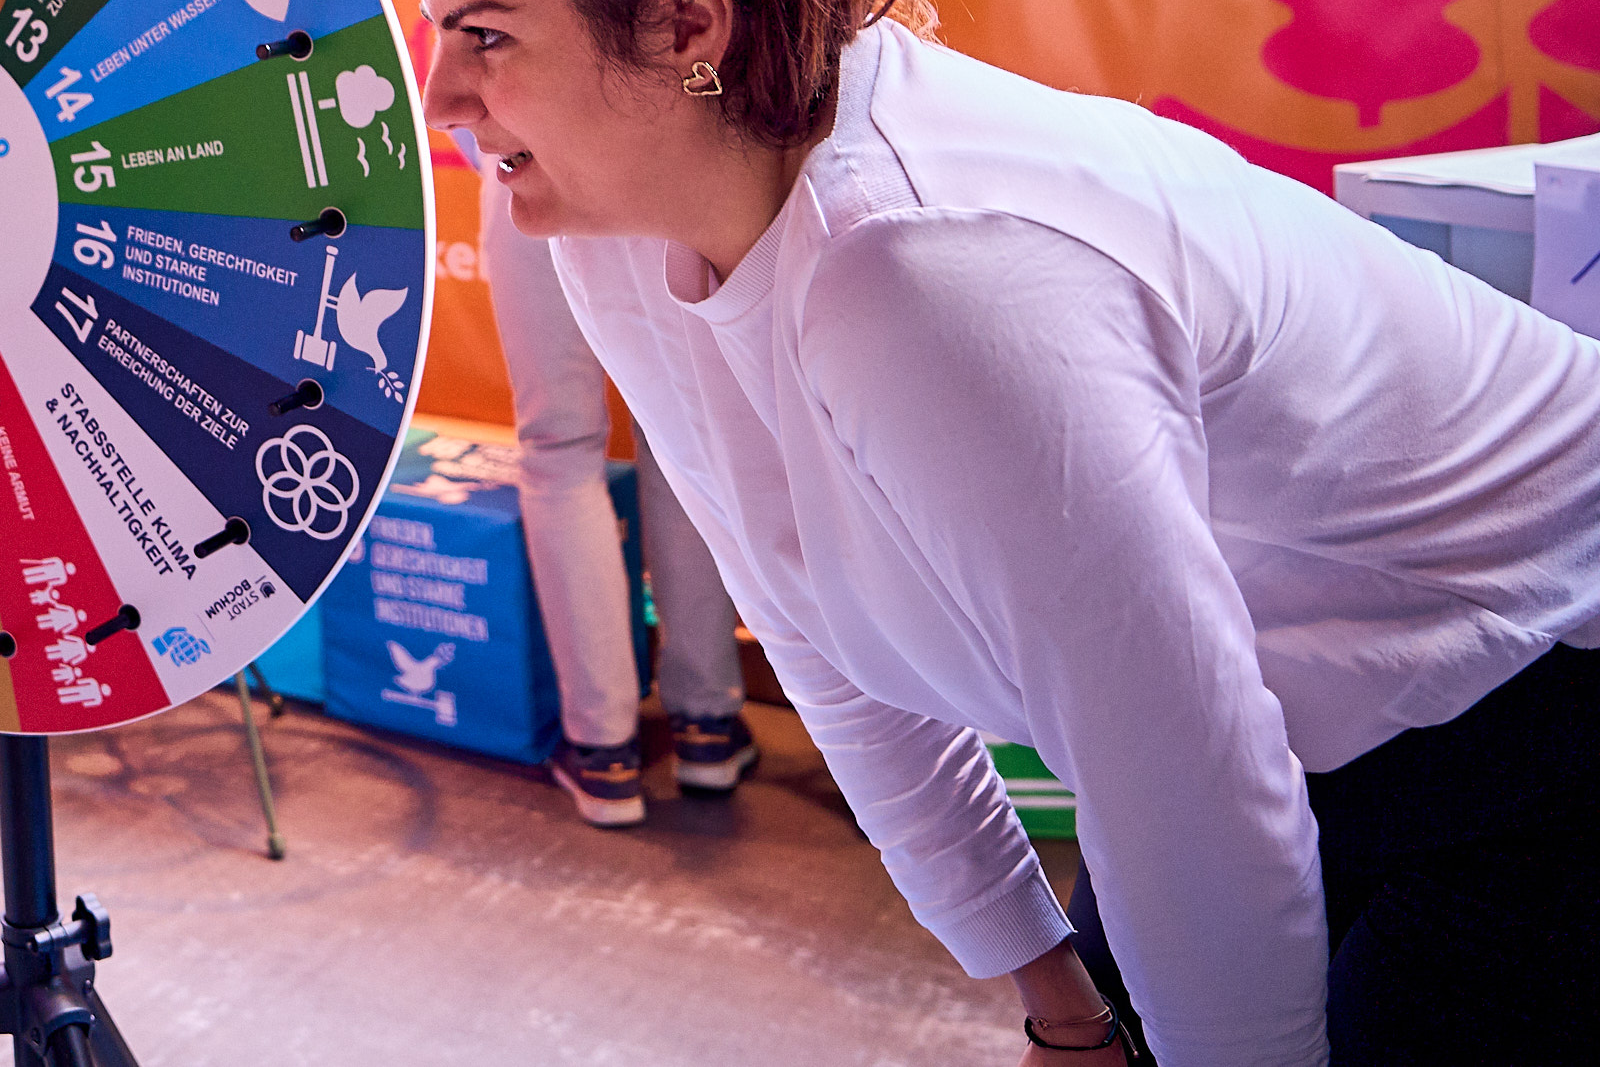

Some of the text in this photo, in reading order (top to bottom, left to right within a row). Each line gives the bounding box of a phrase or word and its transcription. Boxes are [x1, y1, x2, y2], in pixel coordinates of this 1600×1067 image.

[5, 8, 48, 62] 13
[89, 49, 132, 83] LEBEN
[129, 22, 171, 56] UNTER
[45, 66, 94, 122] 14
[70, 141, 116, 192] 15
[121, 140, 224, 169] LEBEN AN LAND
[73, 220, 117, 269] 16
[125, 245, 207, 282] UND STARKE
[127, 226, 299, 287] FRIEDEN, GERECHTIGKEIT
[122, 264, 220, 306] INSTITUTIONEN
[55, 286, 99, 344] 17
[97, 335, 238, 450] ERREICHUNG DER ZIELE
[104, 318, 250, 437] PARTNERSCHAFTEN ZUR
[8, 472, 35, 521] ARMUT
[45, 398, 173, 576] & NACHHALTIGKEIT
[60, 382, 197, 580] STABSSTELLE KLIMA
[205, 579, 251, 619] BOCHUM
[227, 590, 259, 620] STADT
